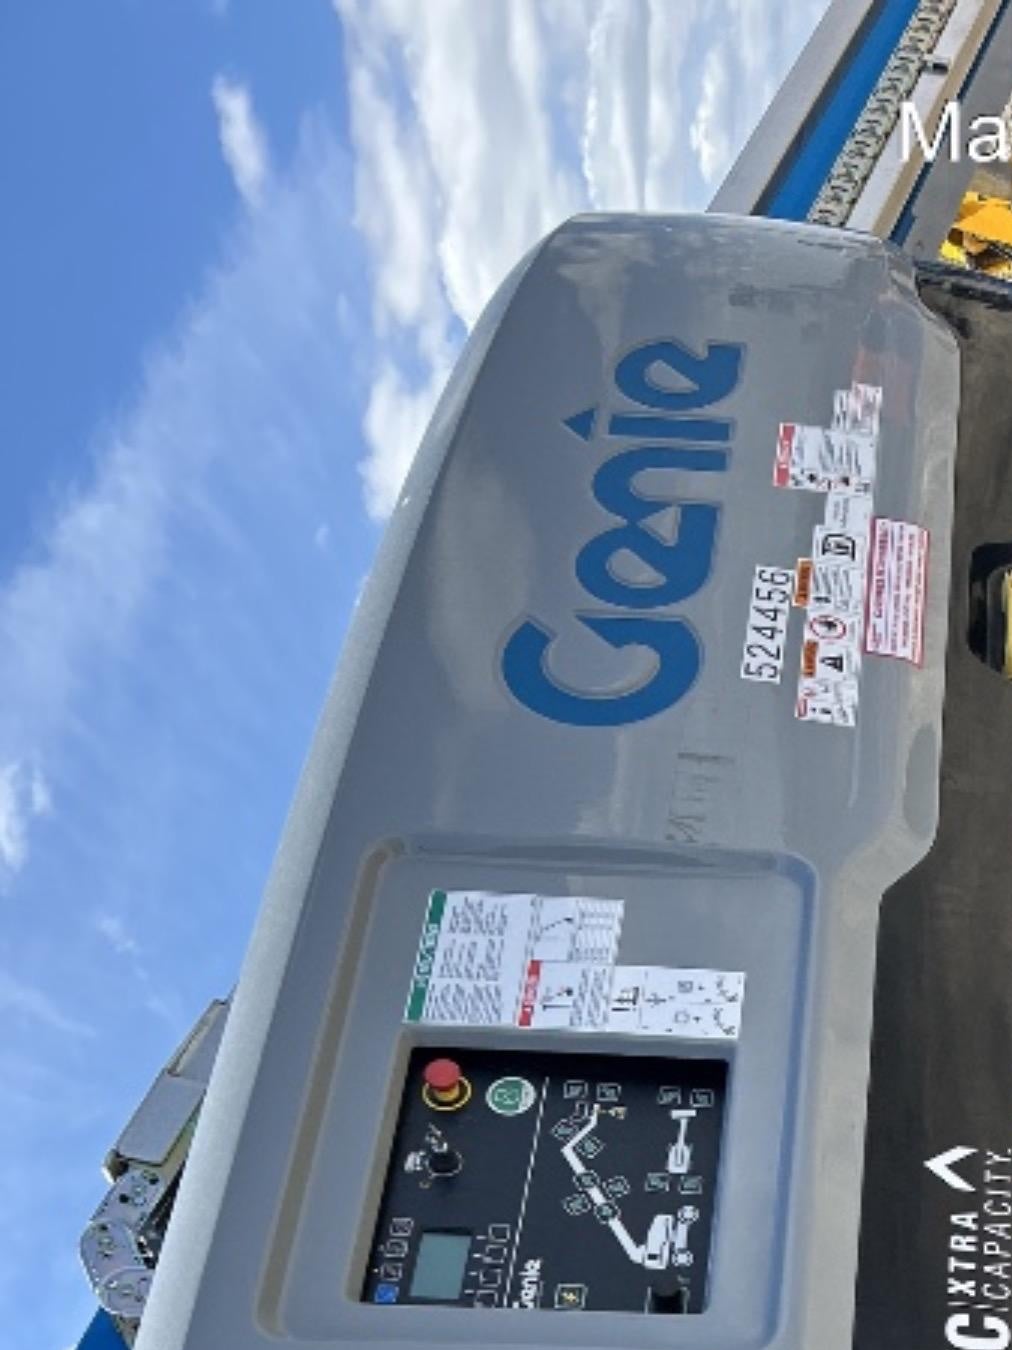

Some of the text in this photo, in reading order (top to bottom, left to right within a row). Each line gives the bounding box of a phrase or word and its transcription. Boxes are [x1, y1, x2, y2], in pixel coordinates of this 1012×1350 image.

[500, 340, 744, 727] Genie
[743, 569, 790, 679] 524456
[947, 1211, 979, 1297] XTRA
